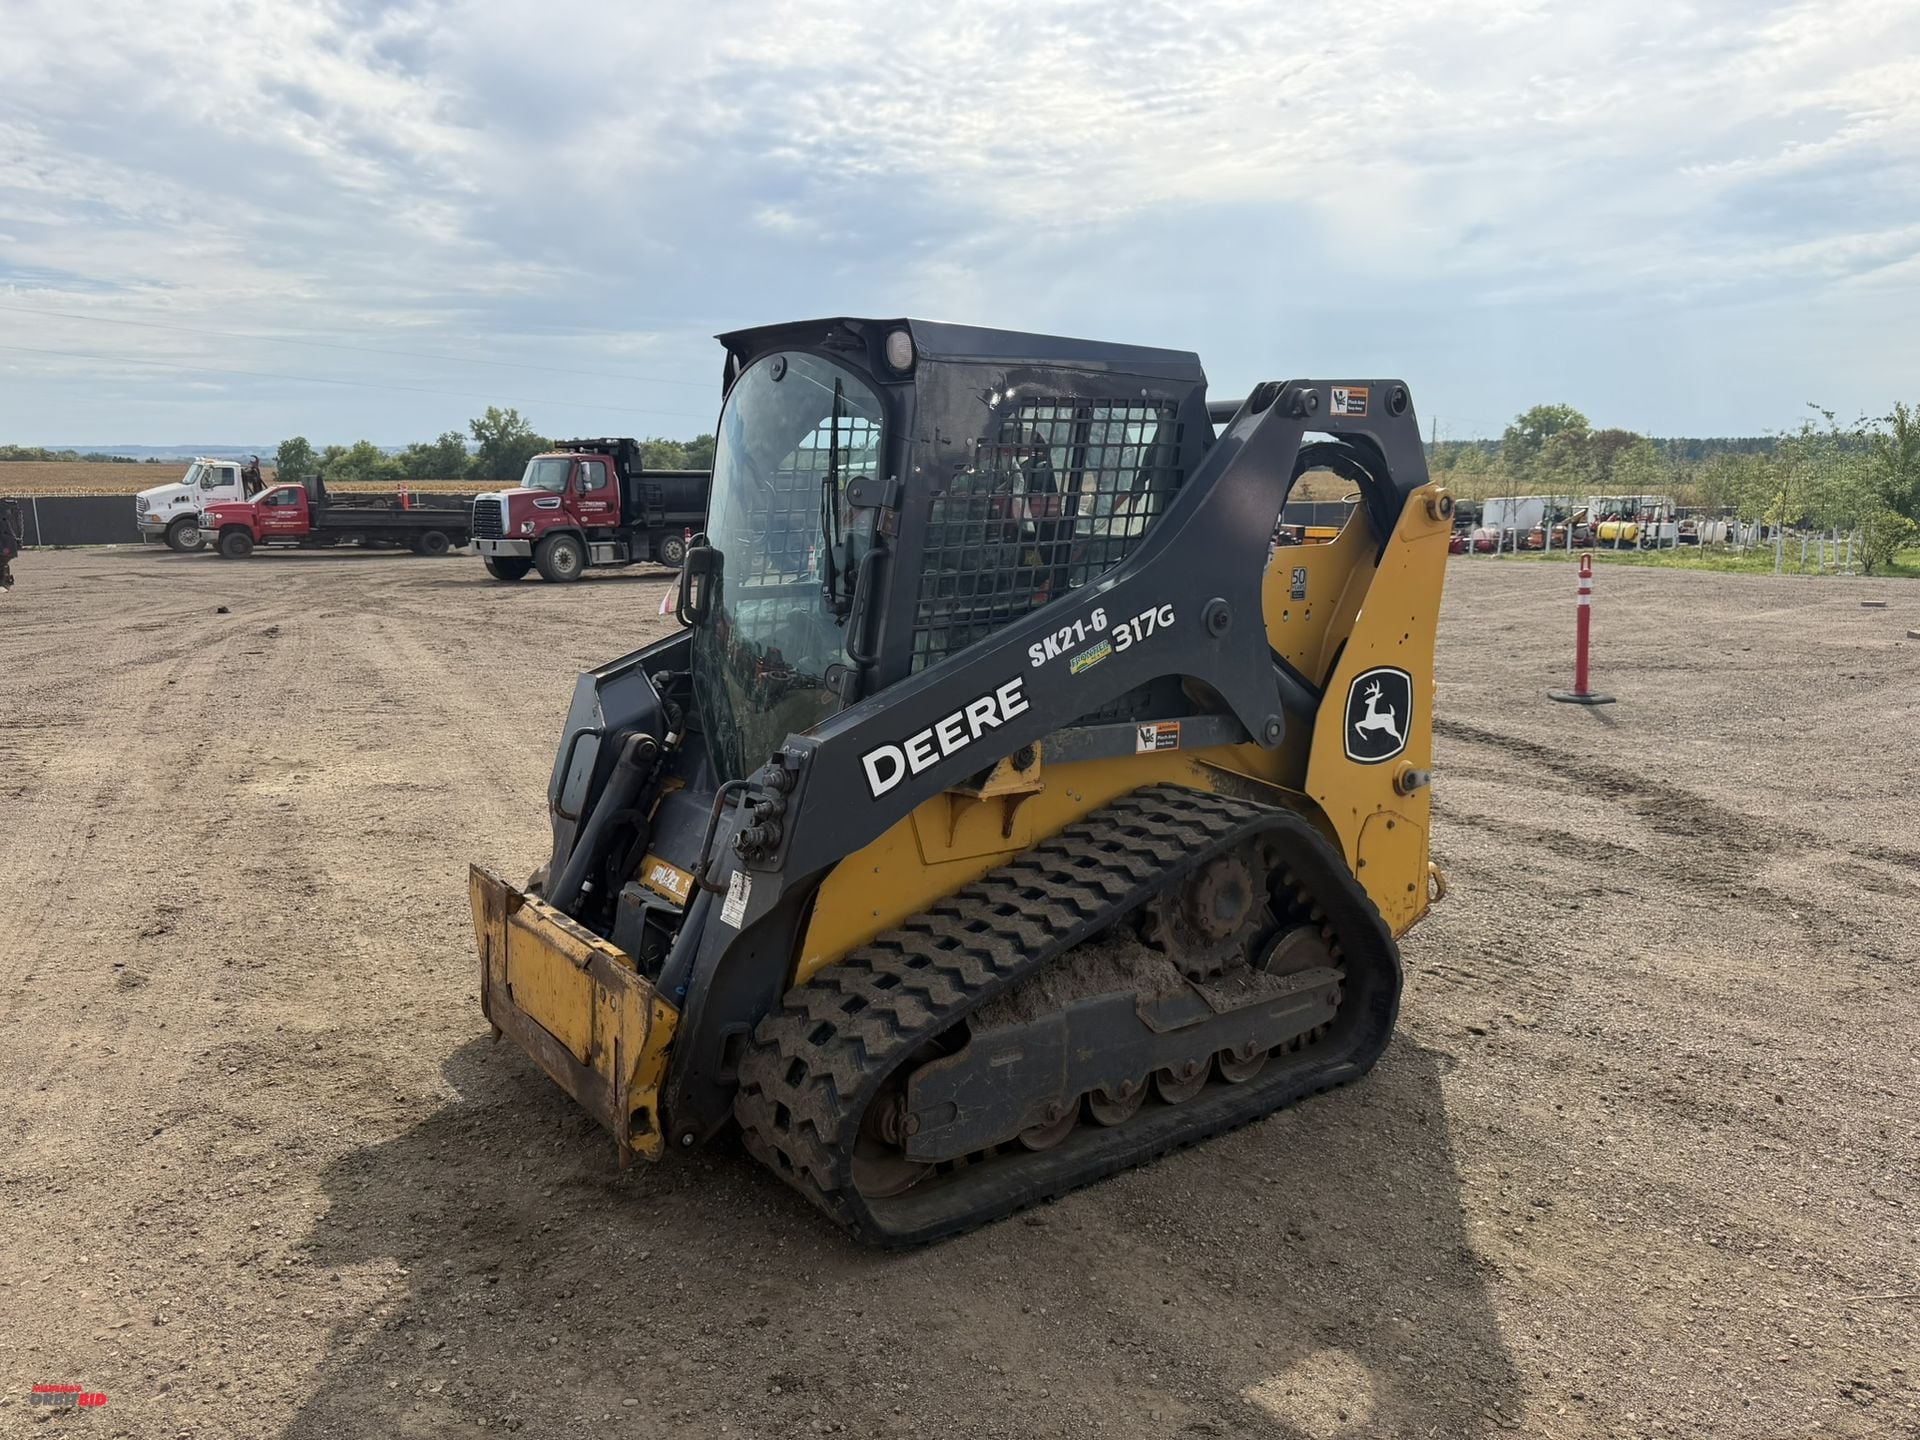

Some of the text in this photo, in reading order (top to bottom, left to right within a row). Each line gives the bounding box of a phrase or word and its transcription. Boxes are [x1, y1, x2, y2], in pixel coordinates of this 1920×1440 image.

[1292, 568, 1306, 584] 50
[1028, 607, 1107, 668] SK21-6
[1112, 604, 1175, 652] 317G
[1071, 640, 1109, 668] FRONTIER
[862, 676, 1030, 798] DEERE
